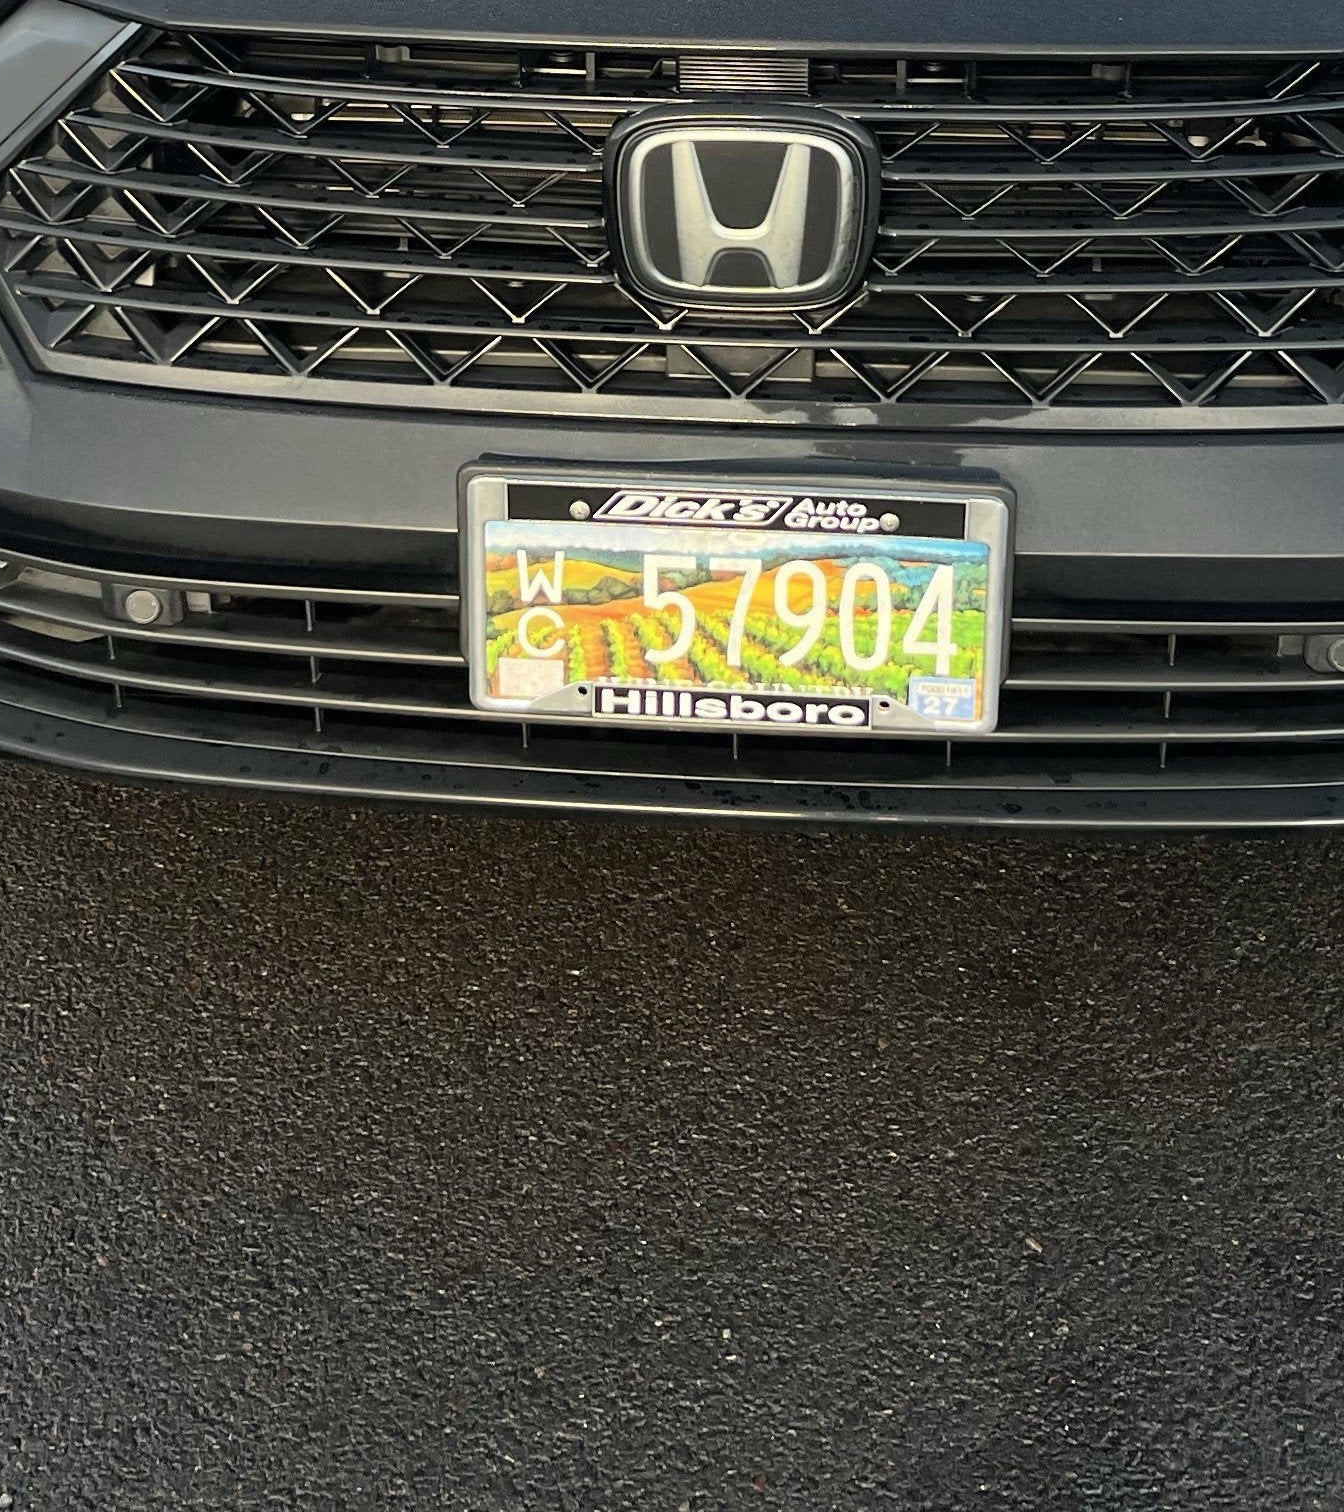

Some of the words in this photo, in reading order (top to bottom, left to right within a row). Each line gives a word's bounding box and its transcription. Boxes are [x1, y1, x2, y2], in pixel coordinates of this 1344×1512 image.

[797, 497, 868, 517] Auto
[784, 512, 880, 532] Group
[642, 554, 957, 676] 57904
[601, 687, 866, 726] Hillsboro
[923, 696, 959, 716] 27
